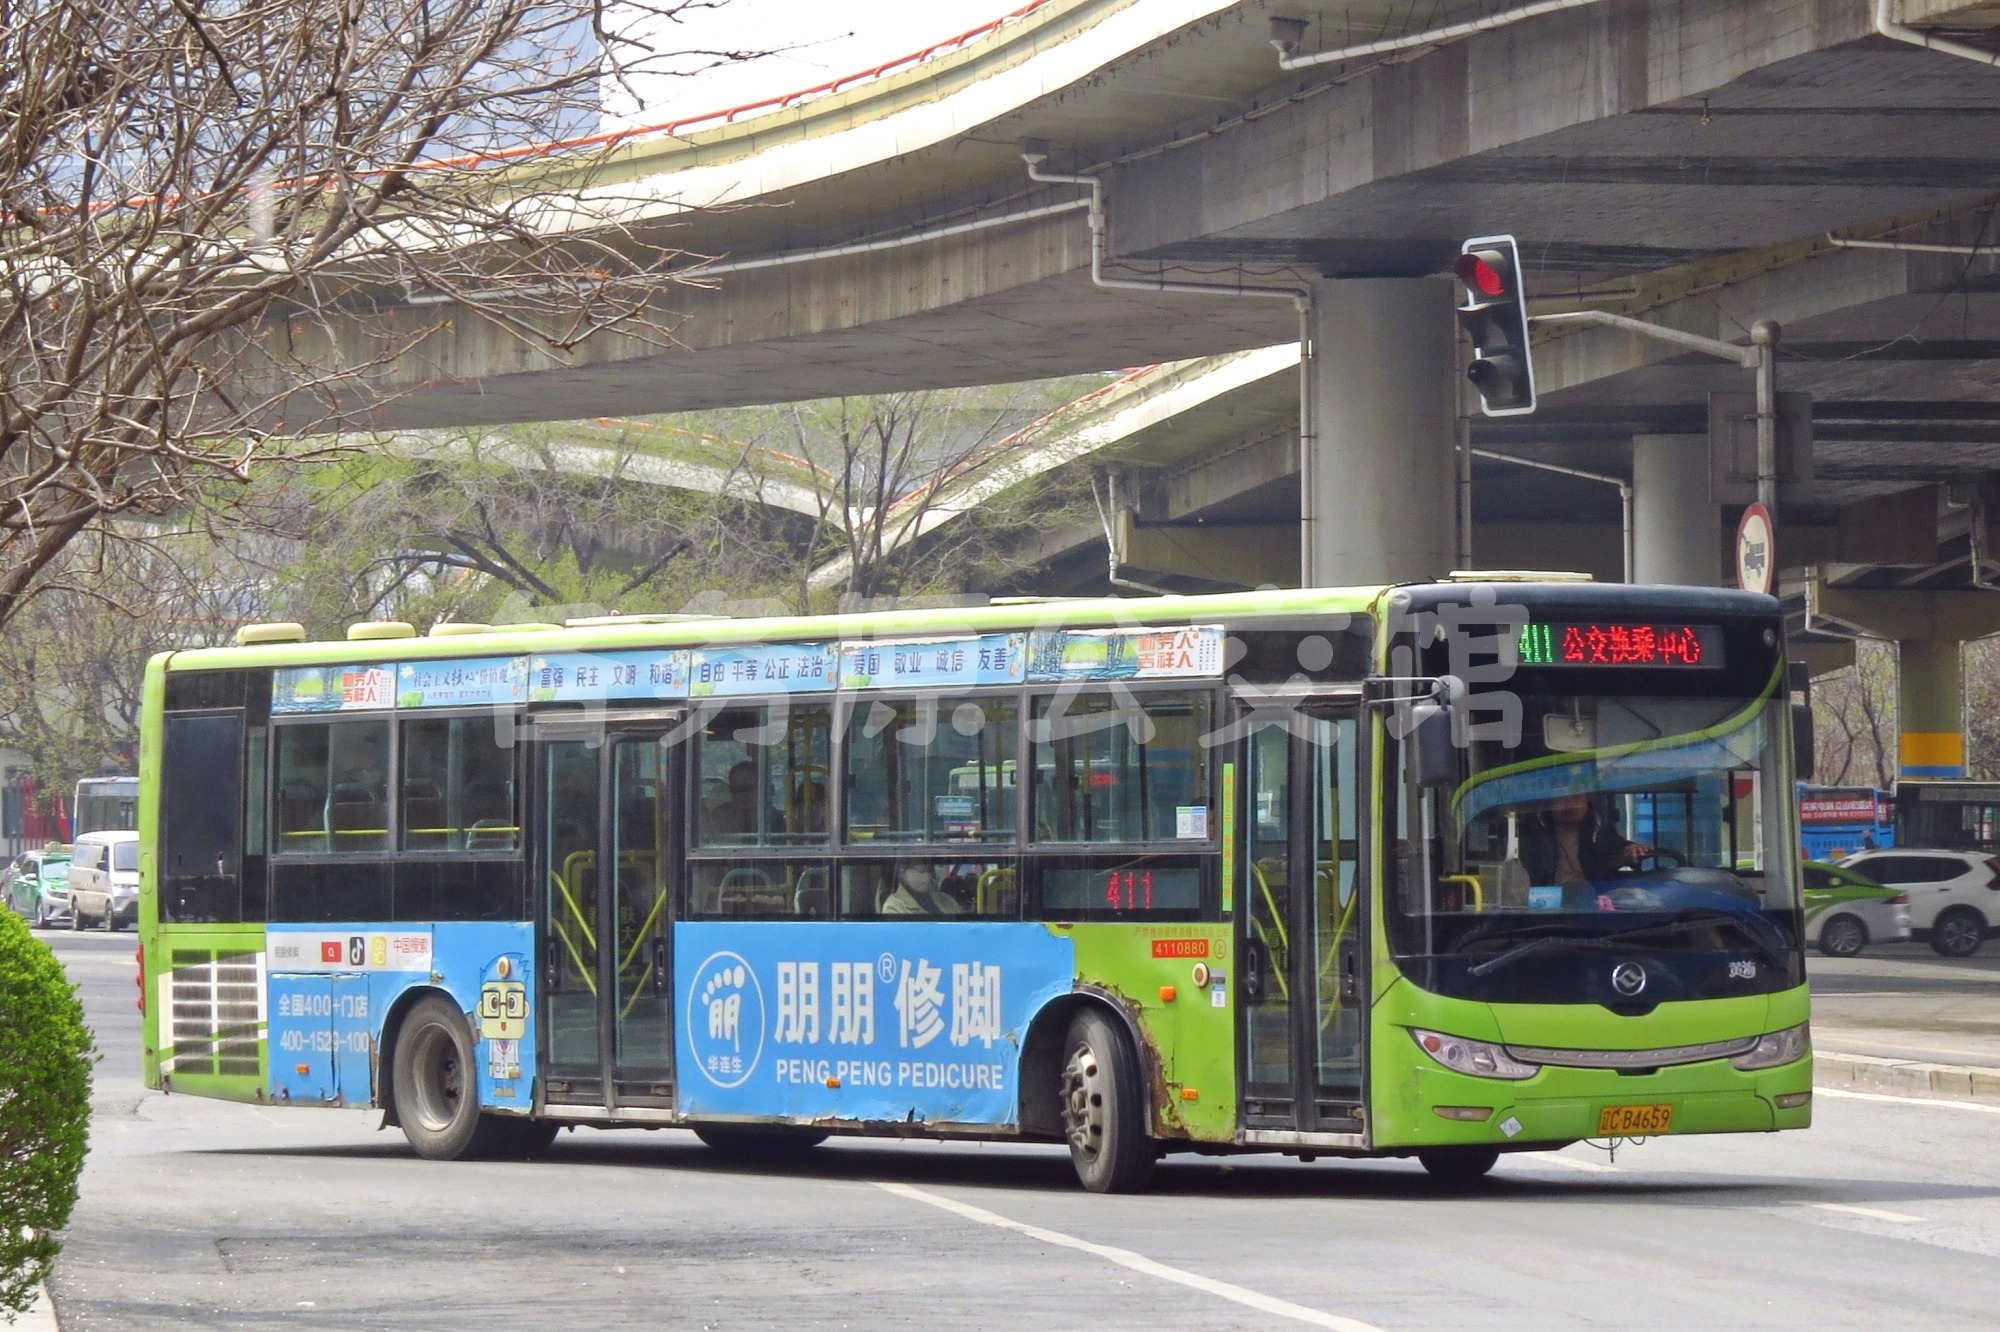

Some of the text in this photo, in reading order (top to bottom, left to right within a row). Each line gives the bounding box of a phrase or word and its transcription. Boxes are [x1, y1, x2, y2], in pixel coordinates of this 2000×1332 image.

[1517, 624, 1553, 662] 411
[1563, 625, 1701, 663] 公交换乘中心
[701, 656, 823, 683] 自由 平等 公正 法治
[853, 647, 1007, 676] 爱国 敬业 诚信 友善
[1138, 651, 1193, 670] 吉祥人
[541, 663, 673, 689] 富强 民主 文明 和谐
[1106, 872, 1152, 910] 411
[393, 937, 428, 954] 中国搜索
[1155, 942, 1206, 955] 4110880
[1729, 960, 1756, 978] 黄海
[279, 993, 368, 1018] 全国400+门店
[280, 1030, 369, 1053] 400-1529-100
[776, 1059, 1004, 1089] PENG PENG PEDICURE
